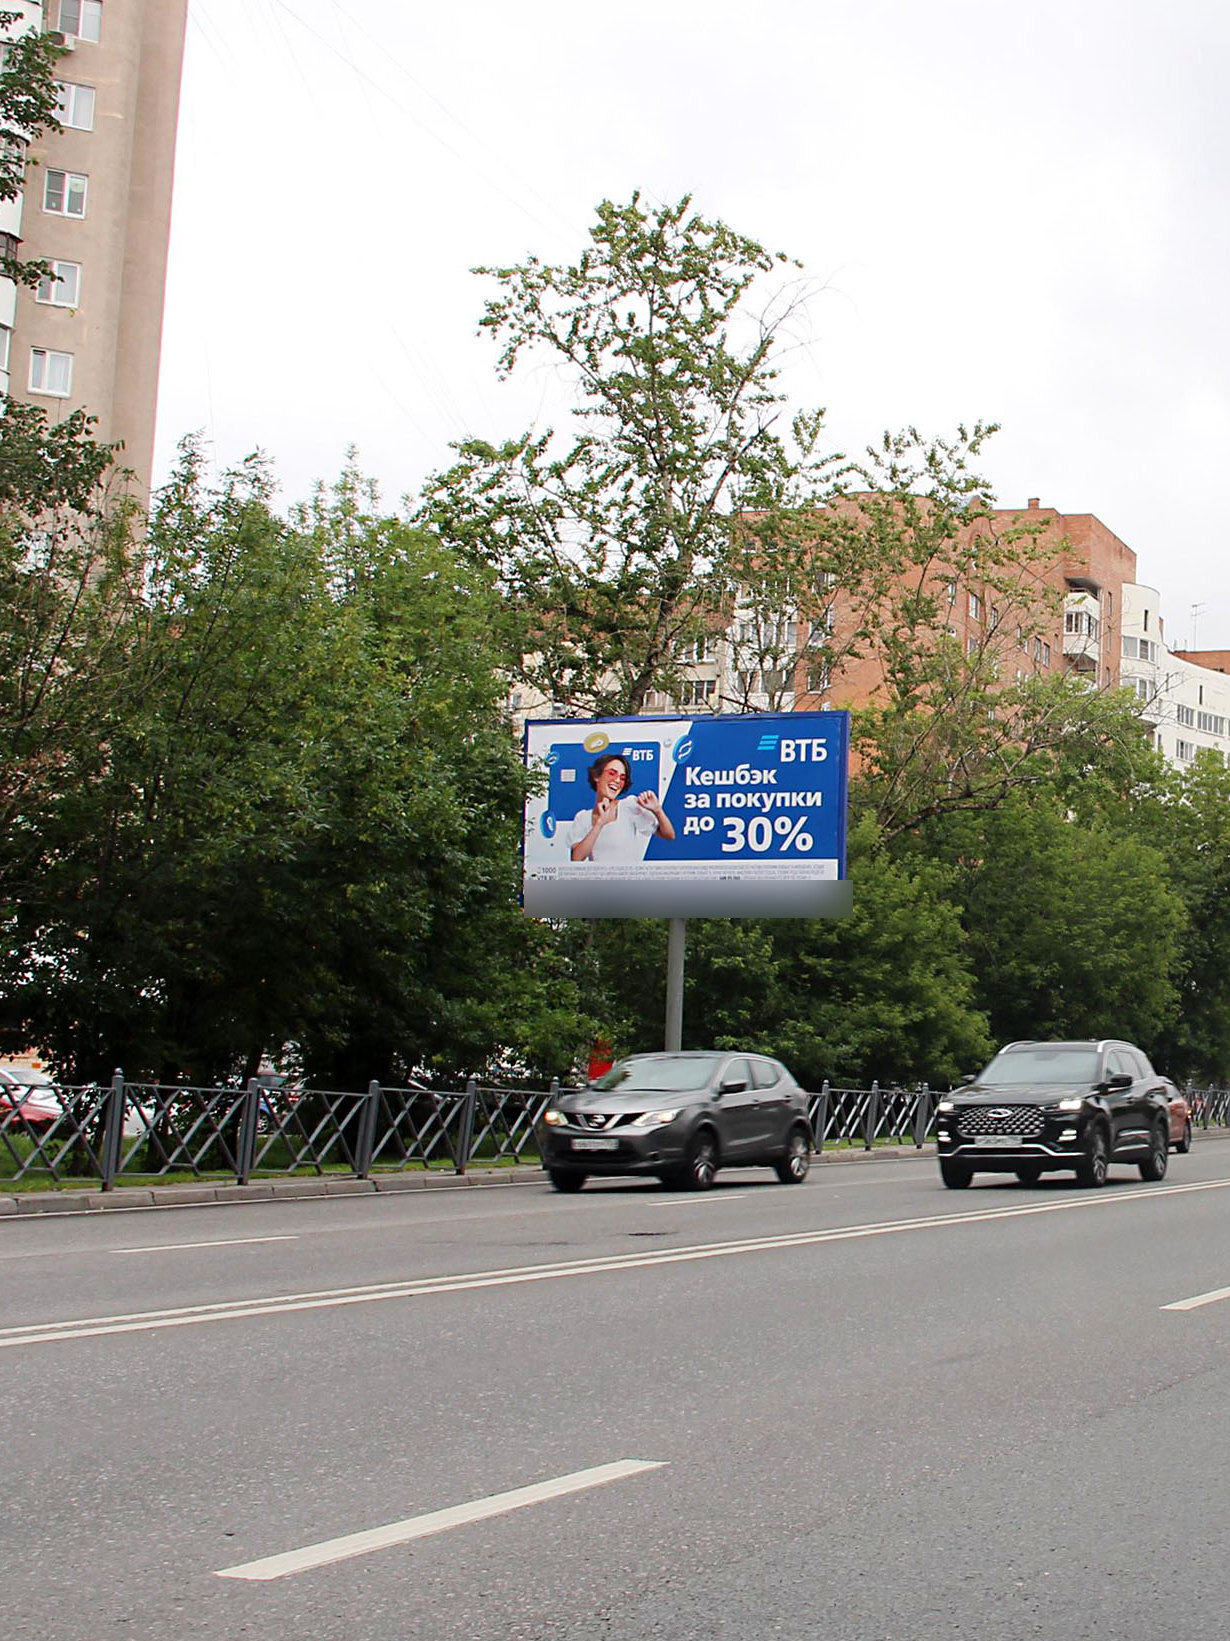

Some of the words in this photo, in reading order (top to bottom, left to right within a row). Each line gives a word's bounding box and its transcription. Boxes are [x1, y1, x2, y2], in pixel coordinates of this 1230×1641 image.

[632, 748, 654, 761] ВТБ
[780, 738, 828, 763] ВТБ
[685, 763, 777, 786] Кешбэк
[684, 793, 711, 809] за
[716, 791, 822, 813] покупки
[684, 816, 715, 835] до
[721, 815, 814, 852] 30%
